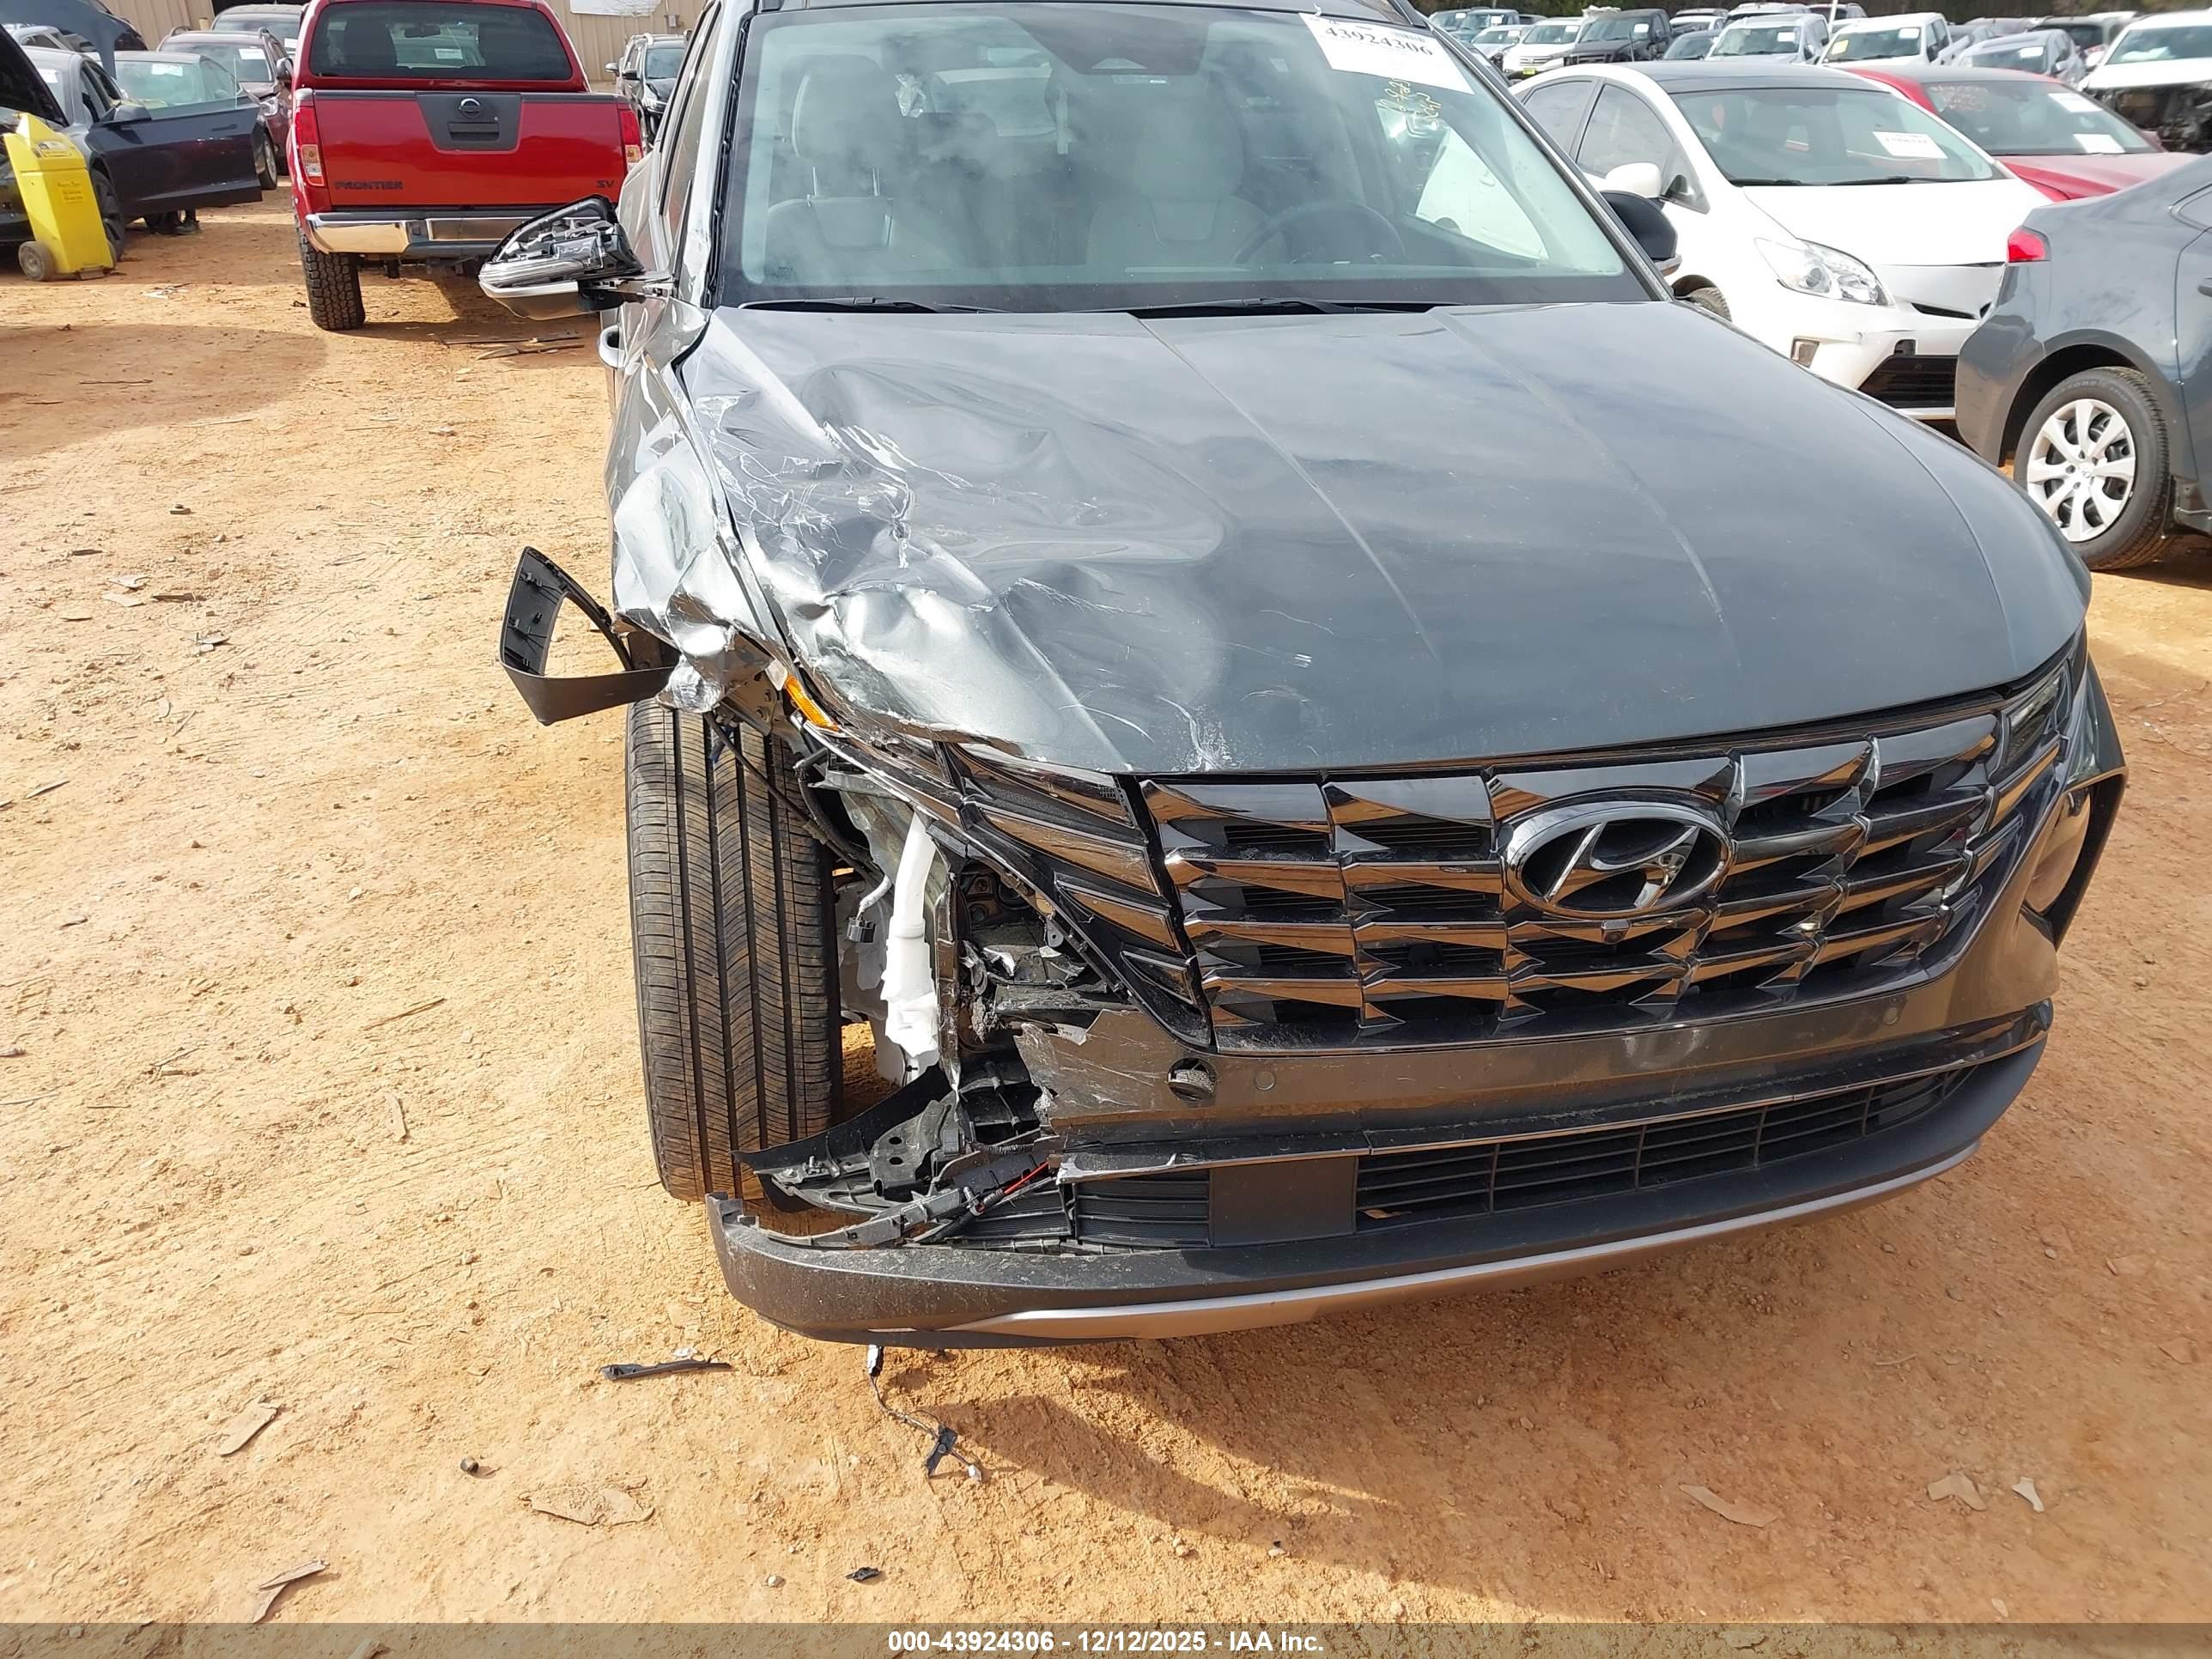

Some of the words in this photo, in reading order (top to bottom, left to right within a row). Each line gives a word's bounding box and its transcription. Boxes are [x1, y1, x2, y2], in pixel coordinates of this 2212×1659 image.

[1325, 27, 1434, 56] 43924306
[335, 180, 403, 190] FRONTIER
[597, 179, 615, 188] SV
